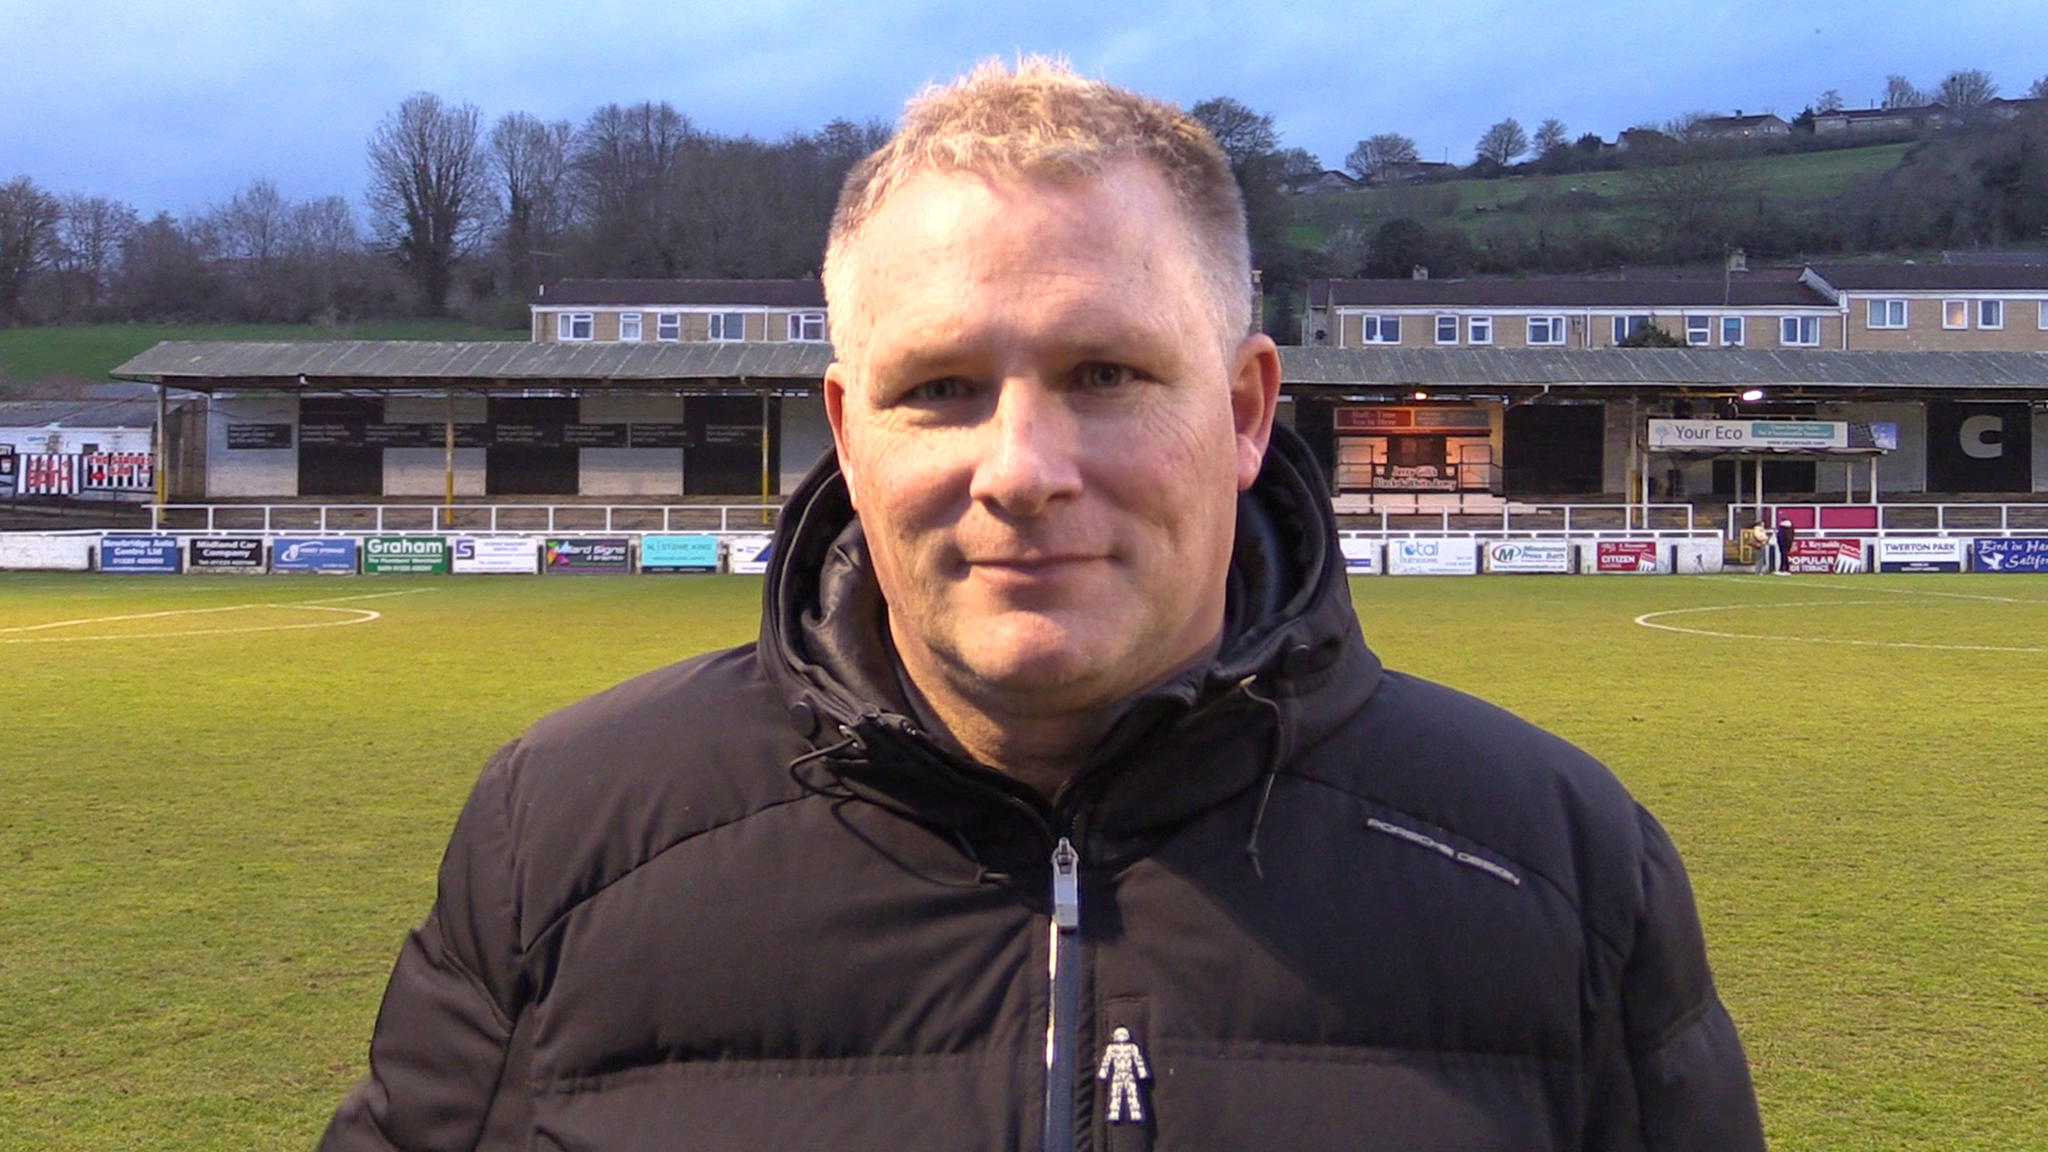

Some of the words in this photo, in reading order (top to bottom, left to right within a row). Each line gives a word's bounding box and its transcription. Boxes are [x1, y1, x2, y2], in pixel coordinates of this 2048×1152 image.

[1675, 425, 1711, 439] Your
[1715, 425, 1743, 440] Eco
[1959, 415, 2003, 459] C
[239, 541, 258, 549] Car
[368, 539, 443, 553] Graham
[1884, 543, 1931, 551] TWERTON
[1978, 540, 2008, 554] Bird
[2011, 541, 2023, 551] in
[1601, 555, 1635, 564] CITIZEN
